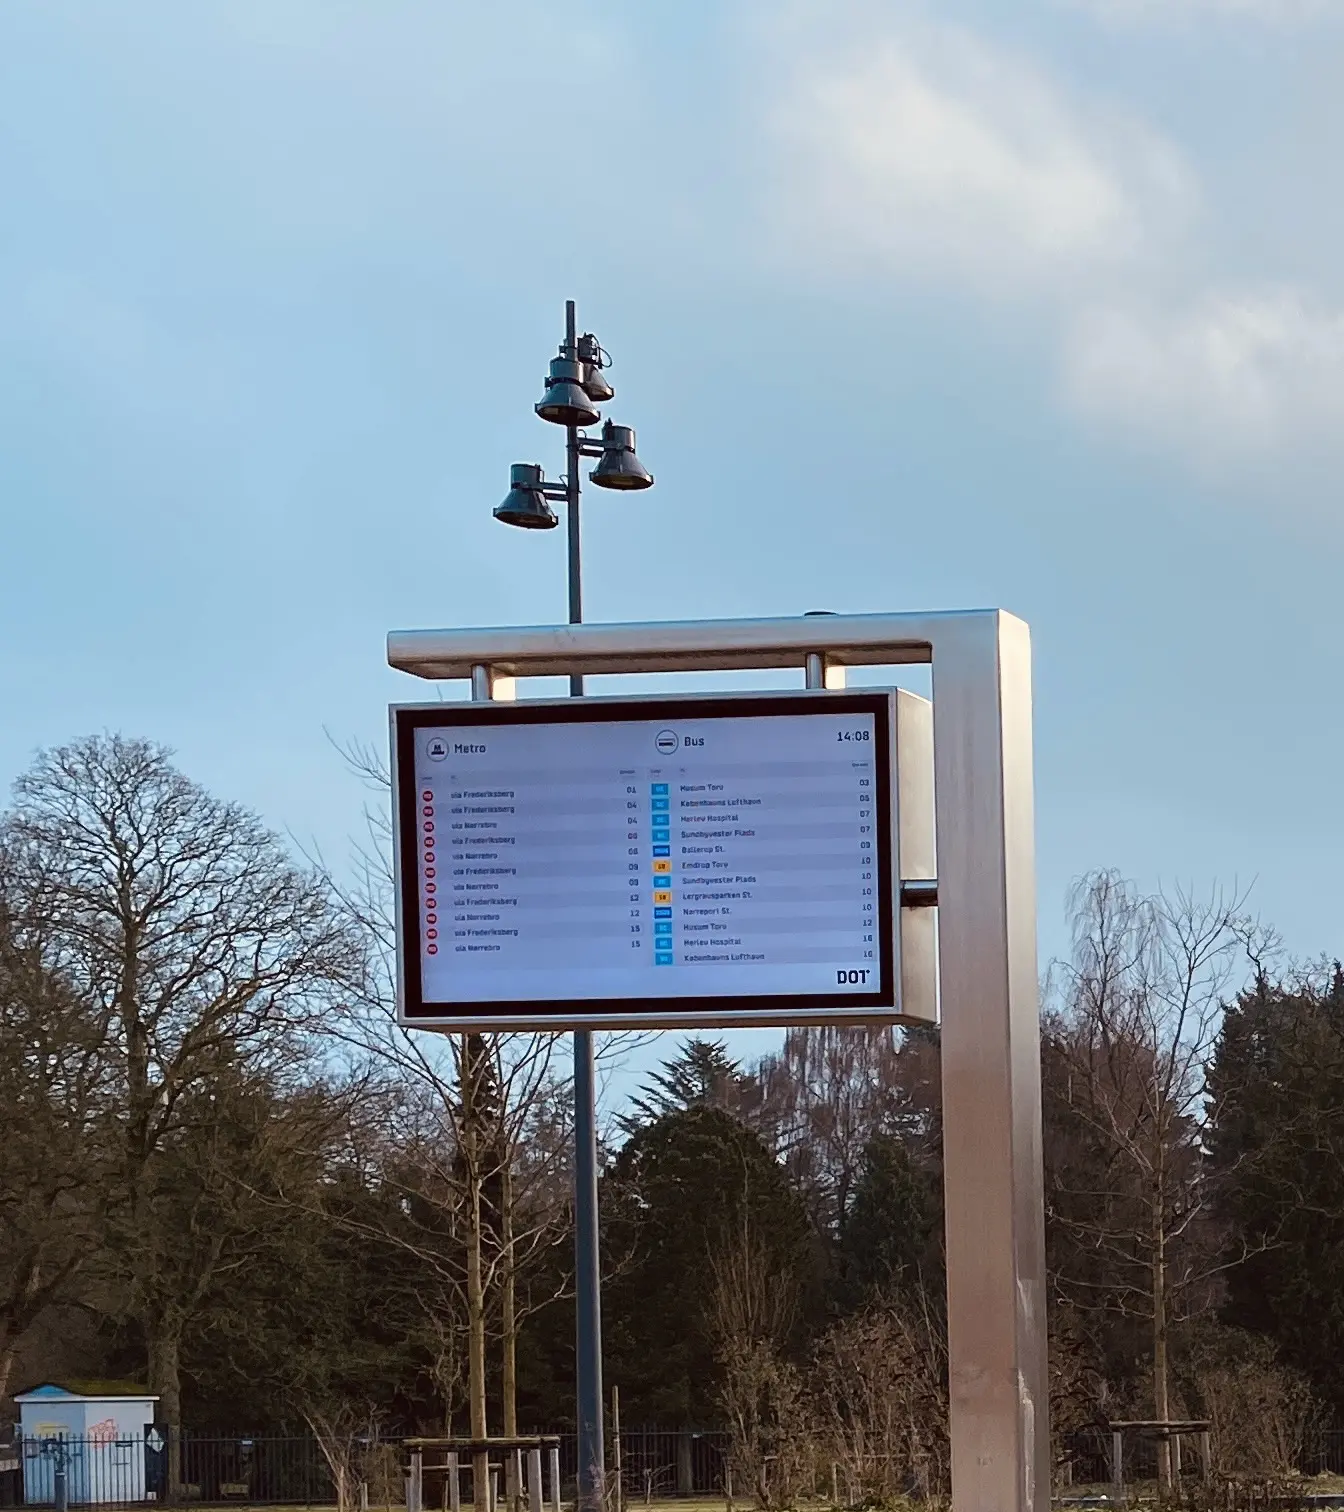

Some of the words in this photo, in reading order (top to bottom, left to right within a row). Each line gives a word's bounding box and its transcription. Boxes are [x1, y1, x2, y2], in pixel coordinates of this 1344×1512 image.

[837, 731, 870, 742] 14:08
[684, 737, 705, 747] Bus
[454, 744, 486, 754] Metro
[860, 810, 870, 818] 07
[862, 872, 872, 880] 10
[837, 969, 871, 984] DOT
